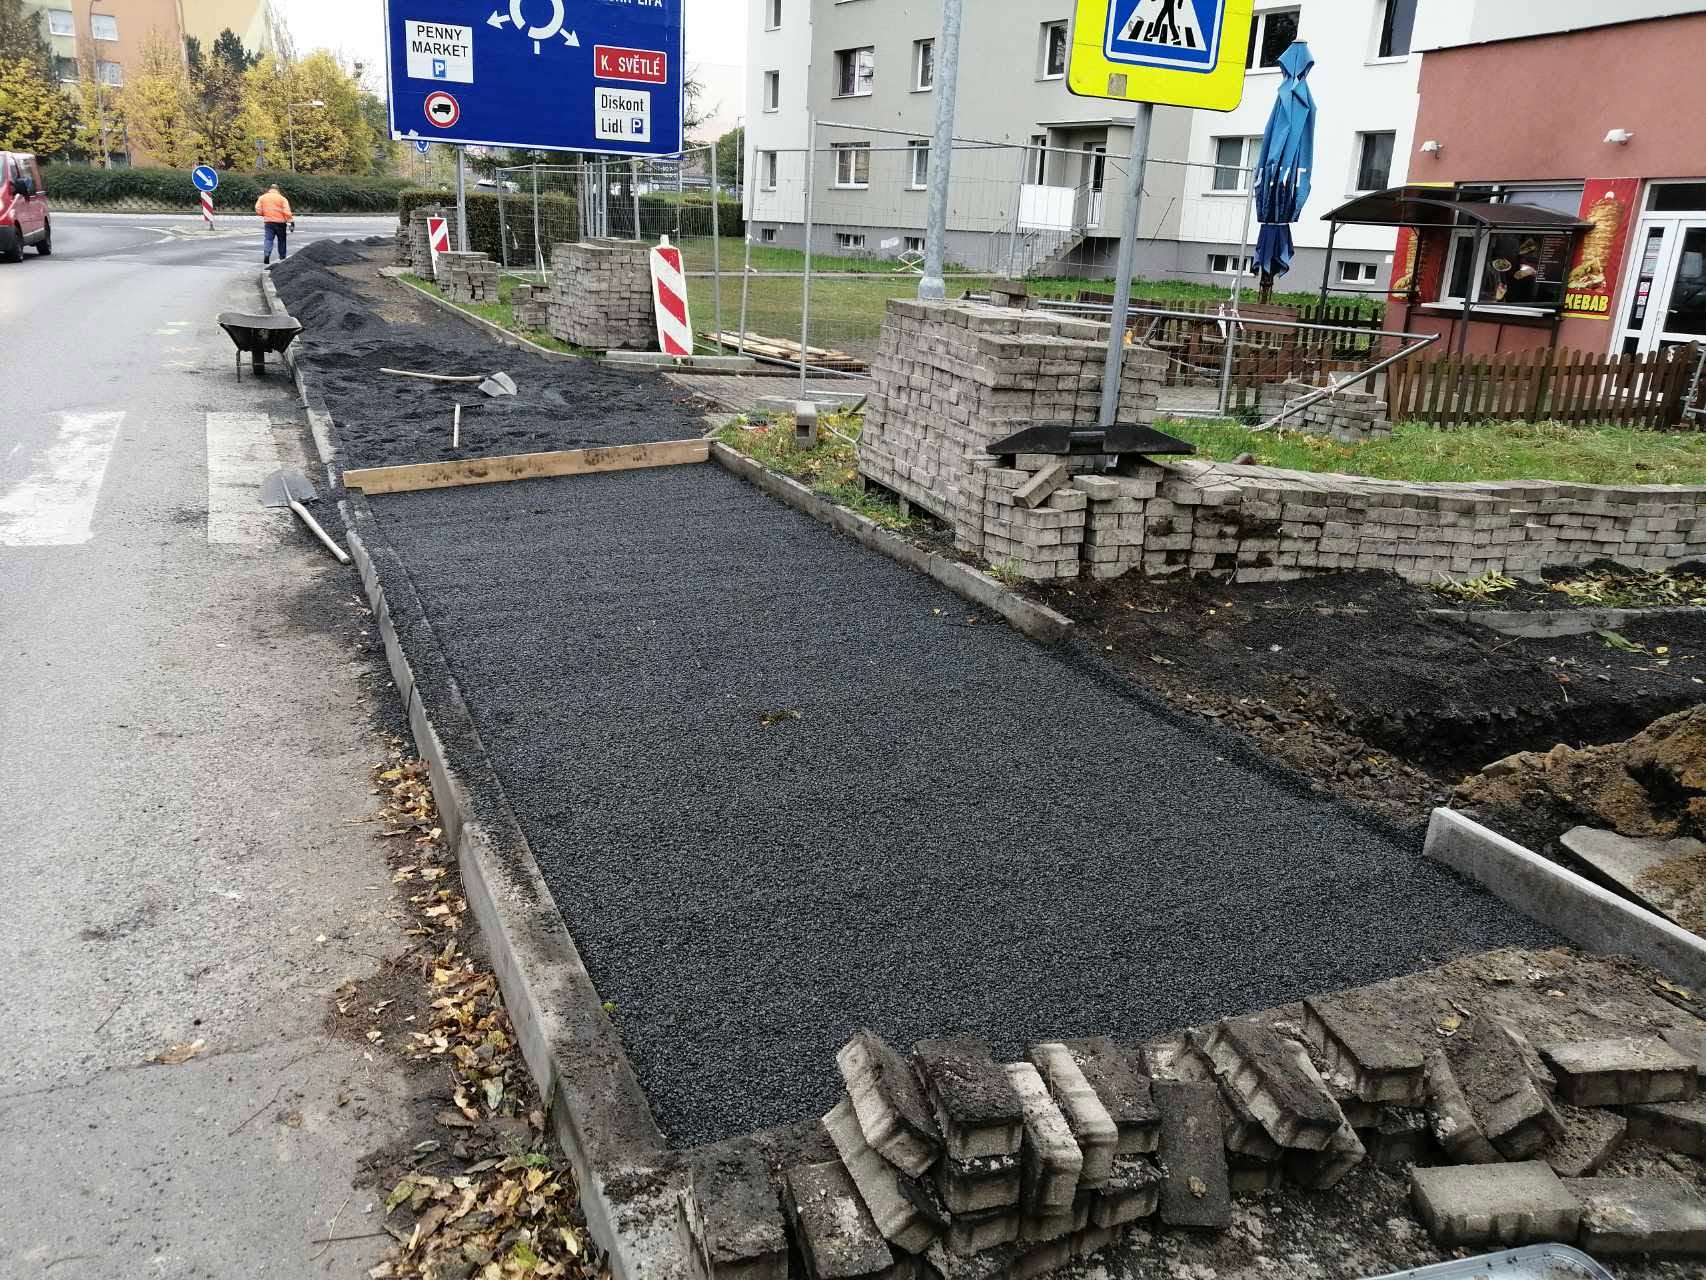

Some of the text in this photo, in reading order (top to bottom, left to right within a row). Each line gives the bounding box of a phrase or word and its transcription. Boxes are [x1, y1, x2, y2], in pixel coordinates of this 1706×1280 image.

[417, 25, 463, 41] PENNY
[412, 40, 469, 57] MARKET
[601, 54, 660, 76] K. SVĚTLÉ
[601, 94, 644, 111] Diskont
[601, 117, 623, 134] Lidl
[1564, 293, 1609, 312] KEBAB
